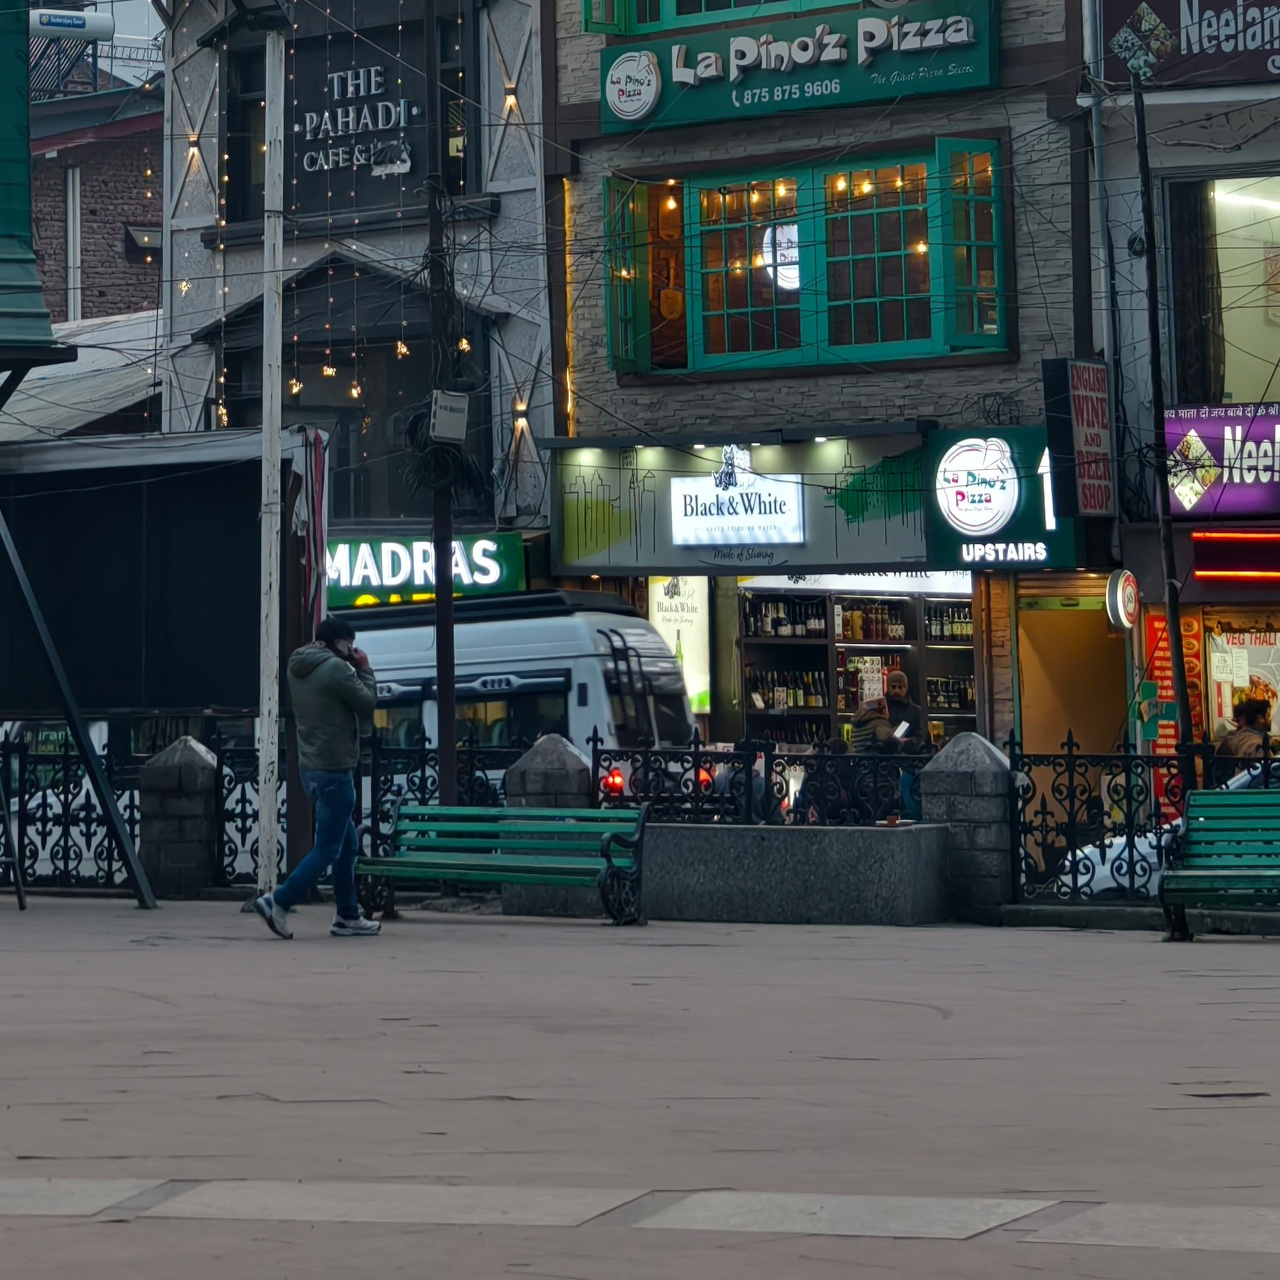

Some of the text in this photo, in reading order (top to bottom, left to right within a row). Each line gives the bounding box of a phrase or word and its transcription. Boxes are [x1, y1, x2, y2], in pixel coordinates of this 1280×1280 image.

[671, 14, 977, 86] La Pino'z Pizza
[328, 66, 385, 100] THE
[610, 74, 621, 85] La
[743, 78, 841, 105] 875 875 9606
[618, 88, 642, 100] Pizza
[304, 99, 409, 140] PAHADI
[303, 145, 369, 171] CAFE &
[1070, 364, 1107, 394] ENGLISH
[1072, 393, 1109, 430] WINE
[1084, 432, 1101, 448] AND
[943, 468, 959, 484] La
[1076, 449, 1111, 482] BEER
[955, 490, 992, 507] Pizza
[1081, 483, 1111, 511] SHOP
[326, 539, 500, 587] MADRAS
[962, 542, 1047, 562] UPSTAIRS
[1226, 631, 1277, 646] VEG THALI
